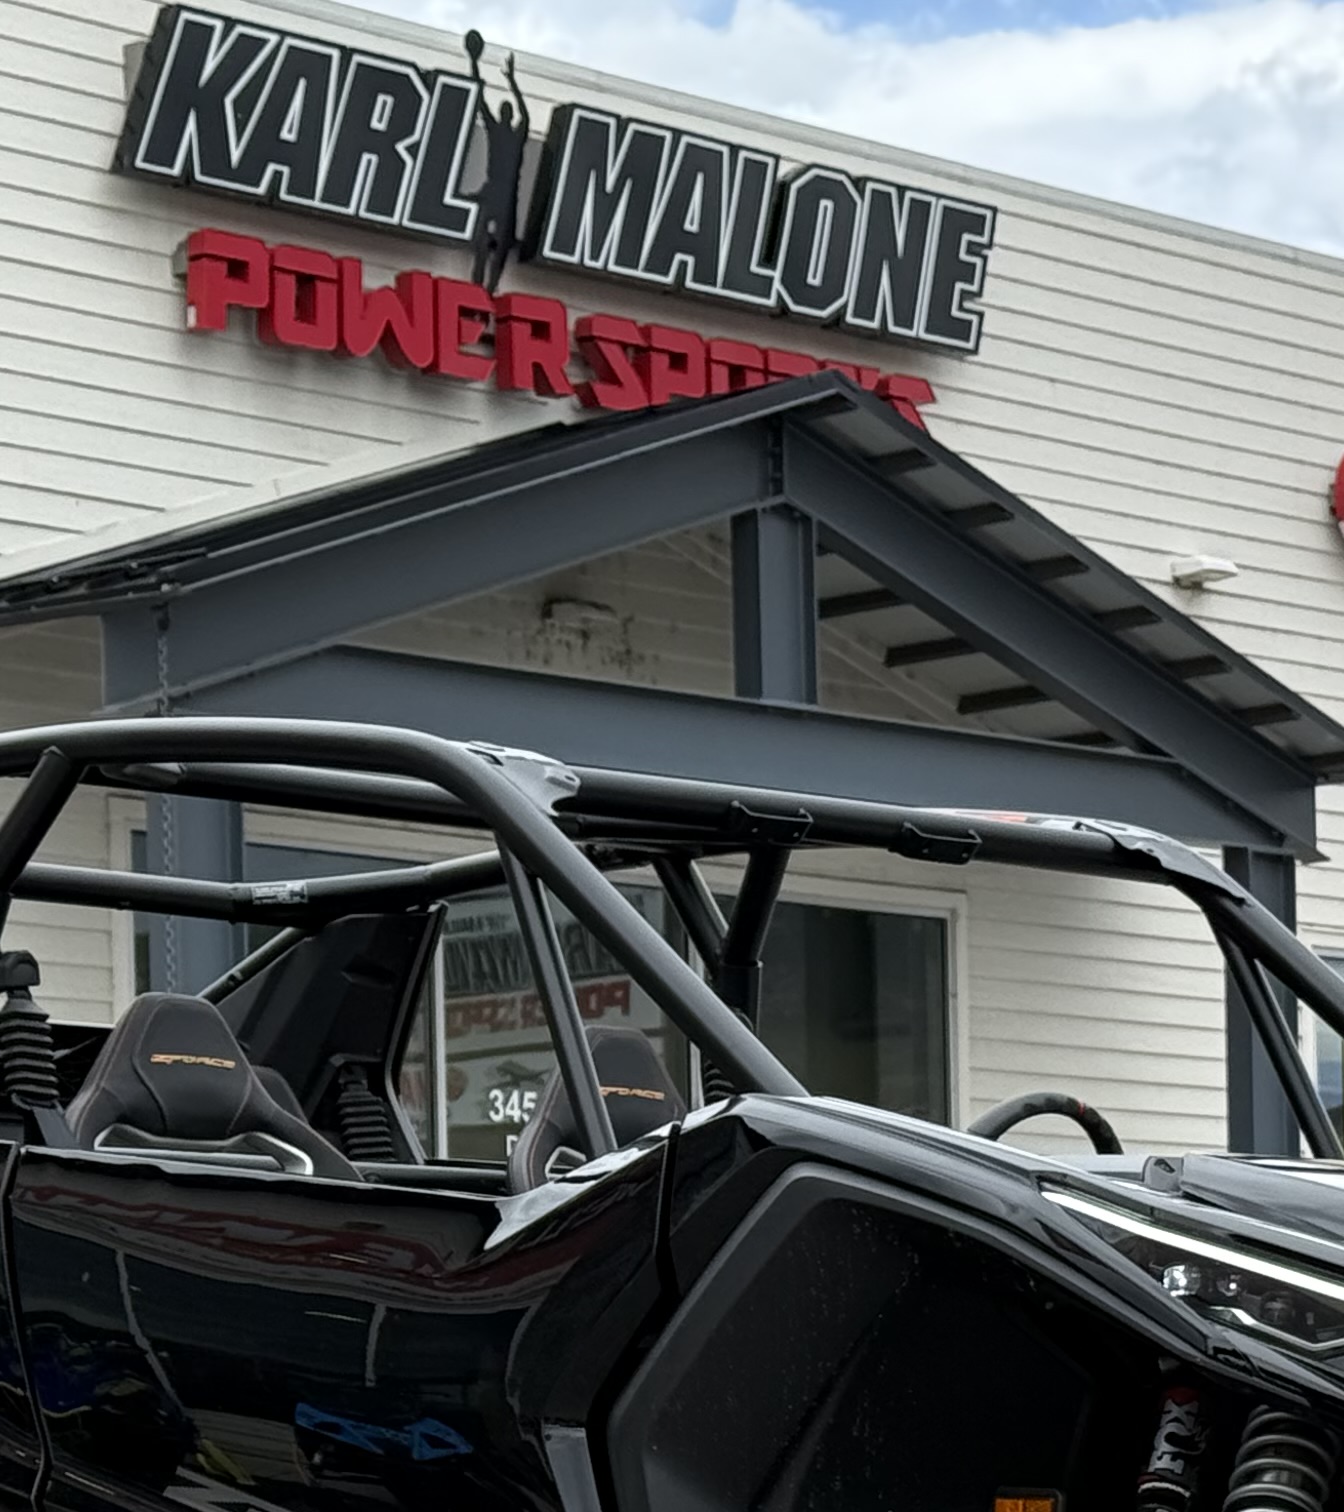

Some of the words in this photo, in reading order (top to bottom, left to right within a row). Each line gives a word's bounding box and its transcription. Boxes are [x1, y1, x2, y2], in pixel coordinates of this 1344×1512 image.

[134, 8, 481, 243] KARL
[540, 107, 998, 352] MALONE
[186, 227, 936, 432] POWERSPO
[598, 1086, 665, 1101] FORCE
[1147, 1399, 1202, 1475] FOX
